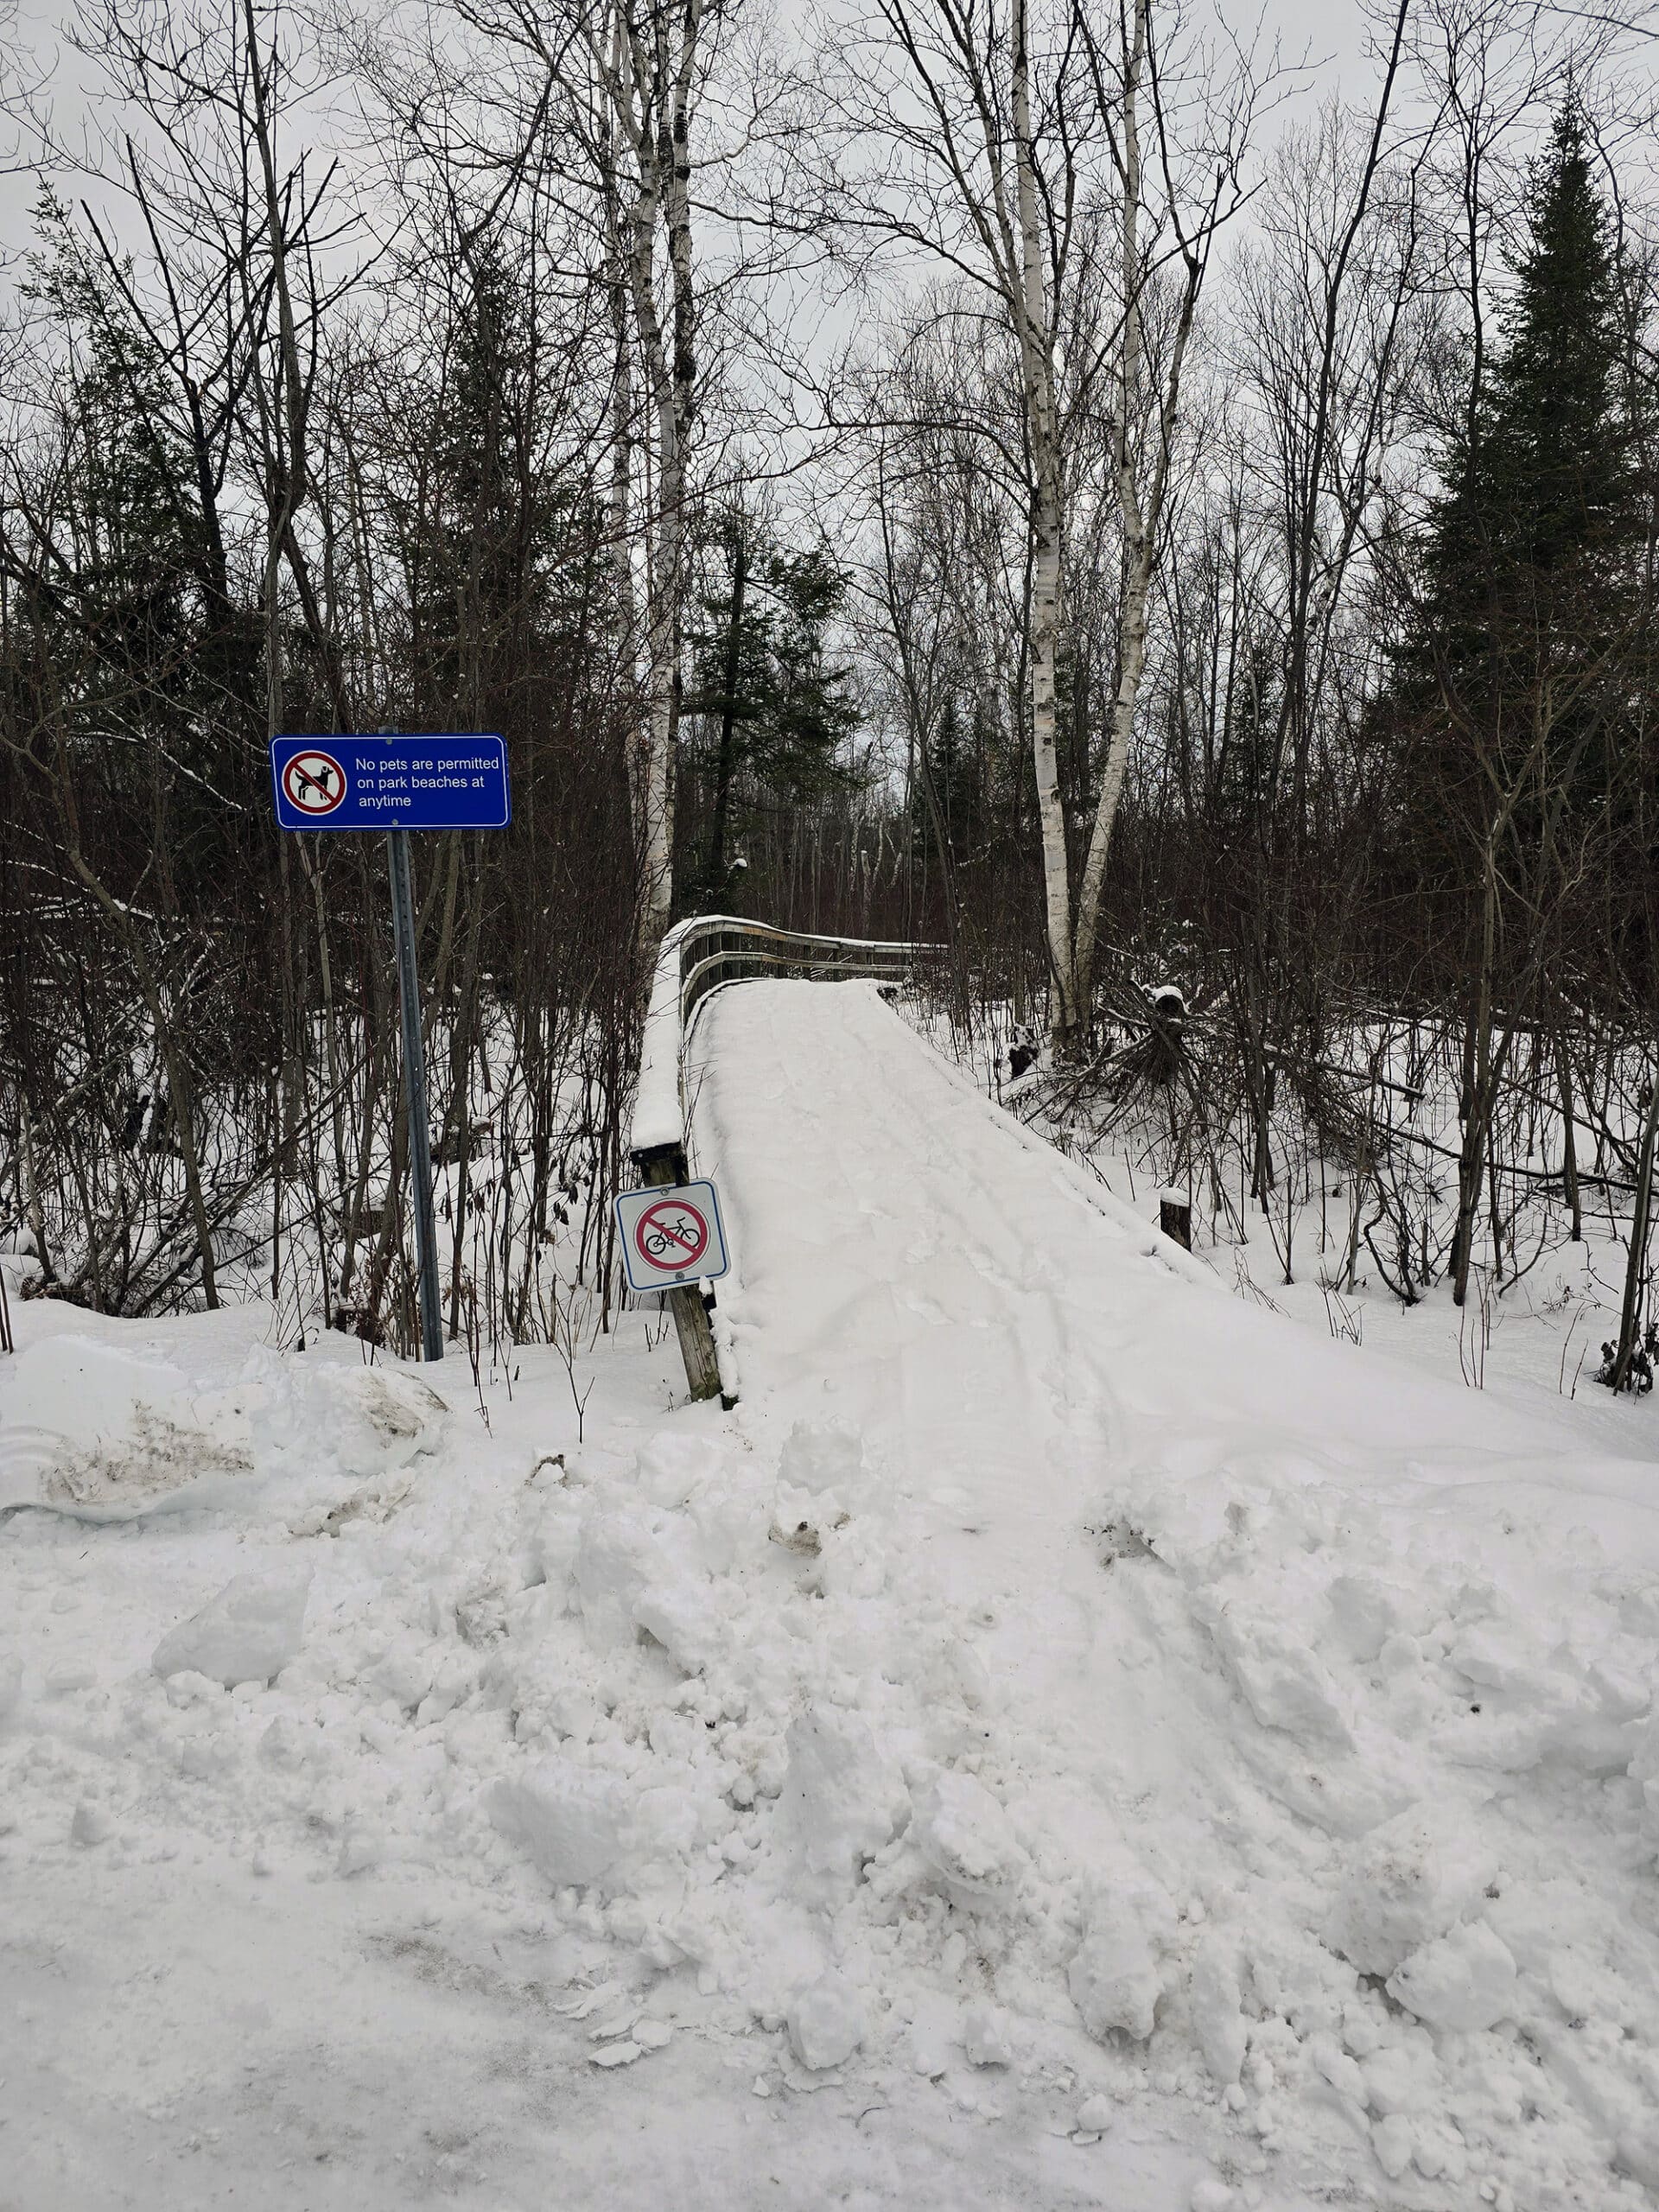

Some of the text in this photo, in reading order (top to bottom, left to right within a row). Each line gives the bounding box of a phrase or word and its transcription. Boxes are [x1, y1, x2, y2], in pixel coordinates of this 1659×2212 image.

[356, 757, 499, 772] No pets are permitted
[358, 776, 484, 791] on park beaches at
[359, 795, 410, 809] anytime
